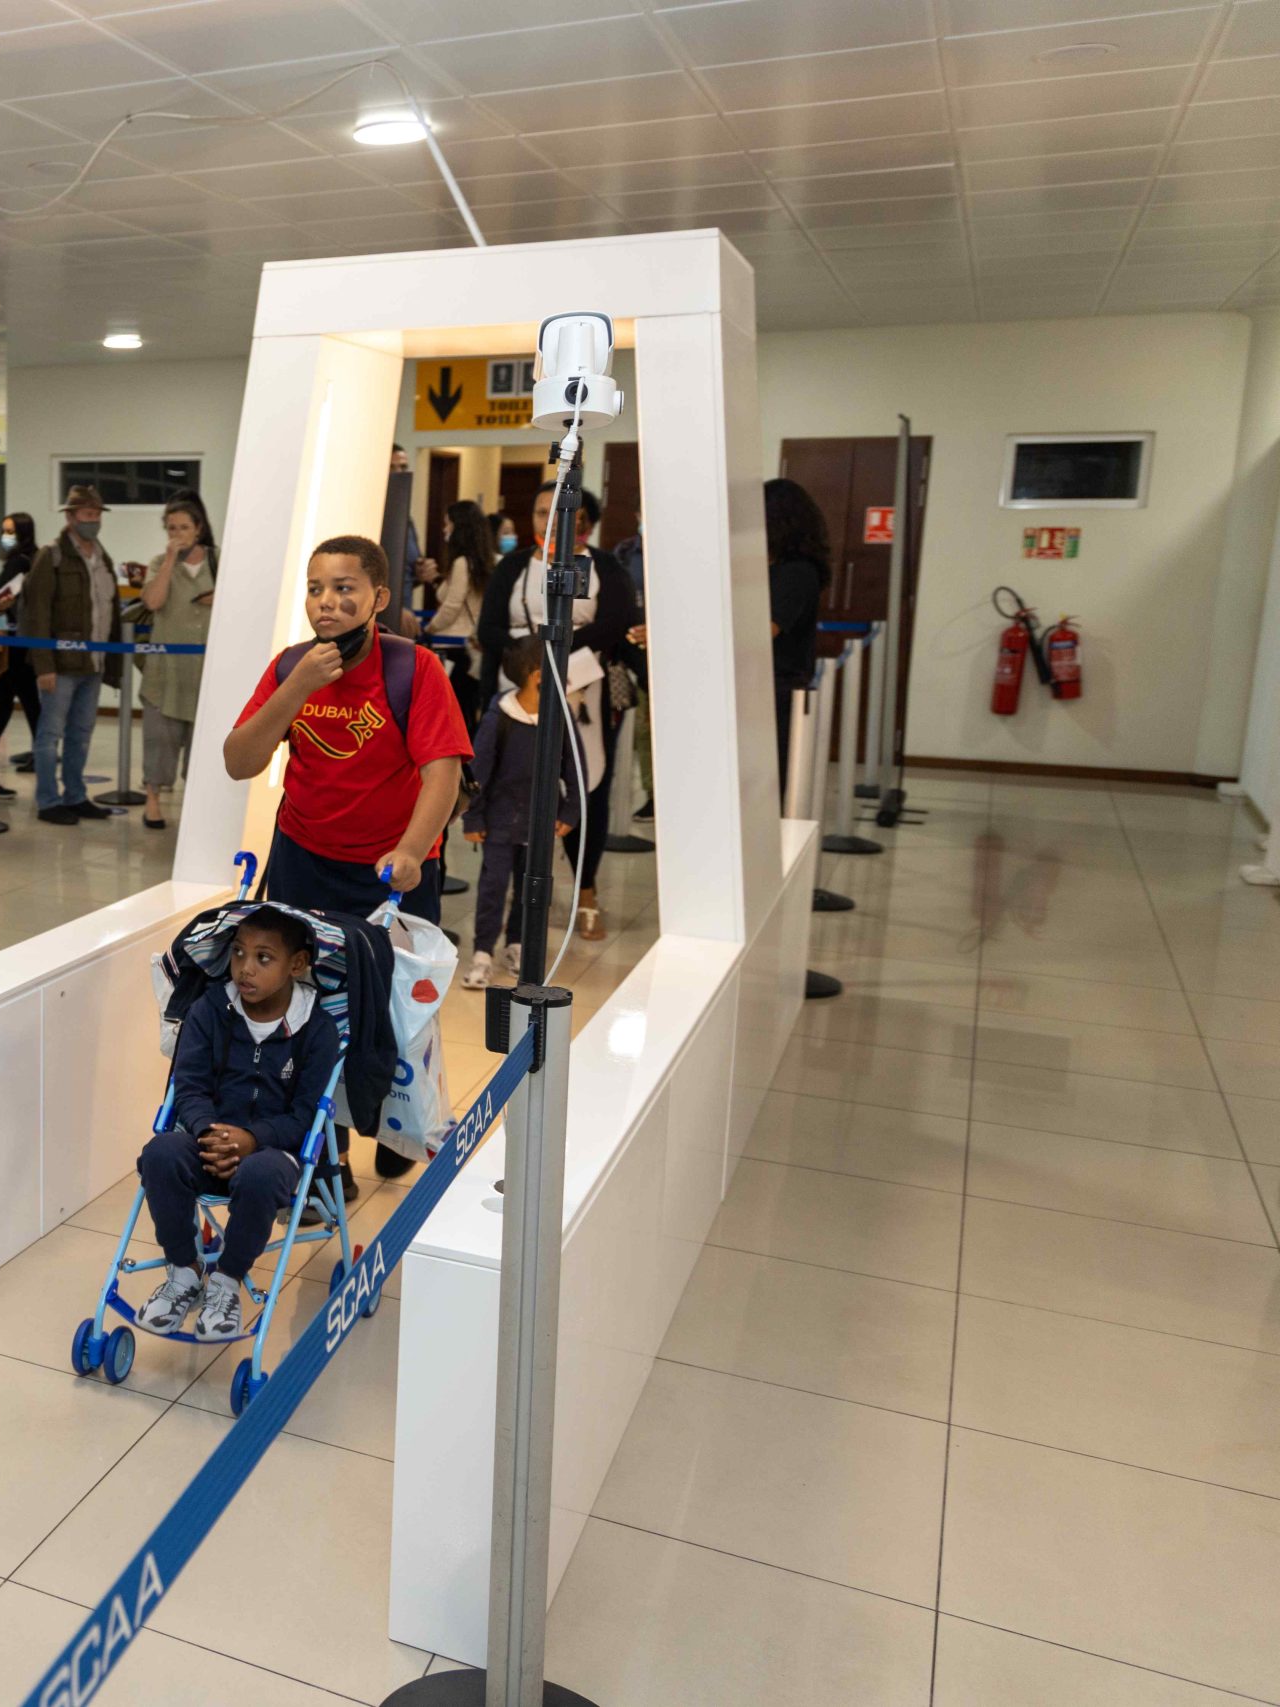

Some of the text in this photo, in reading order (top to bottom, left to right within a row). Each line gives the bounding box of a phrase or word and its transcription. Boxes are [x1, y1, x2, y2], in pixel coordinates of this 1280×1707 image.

[488, 399, 532, 411] TOILE
[475, 413, 533, 426] TOILET
[56, 639, 87, 650] SCAA
[134, 643, 167, 654] SCAA
[302, 703, 353, 720] DUBAI
[455, 1090, 493, 1166] SCAA
[326, 1241, 385, 1353] SCAA
